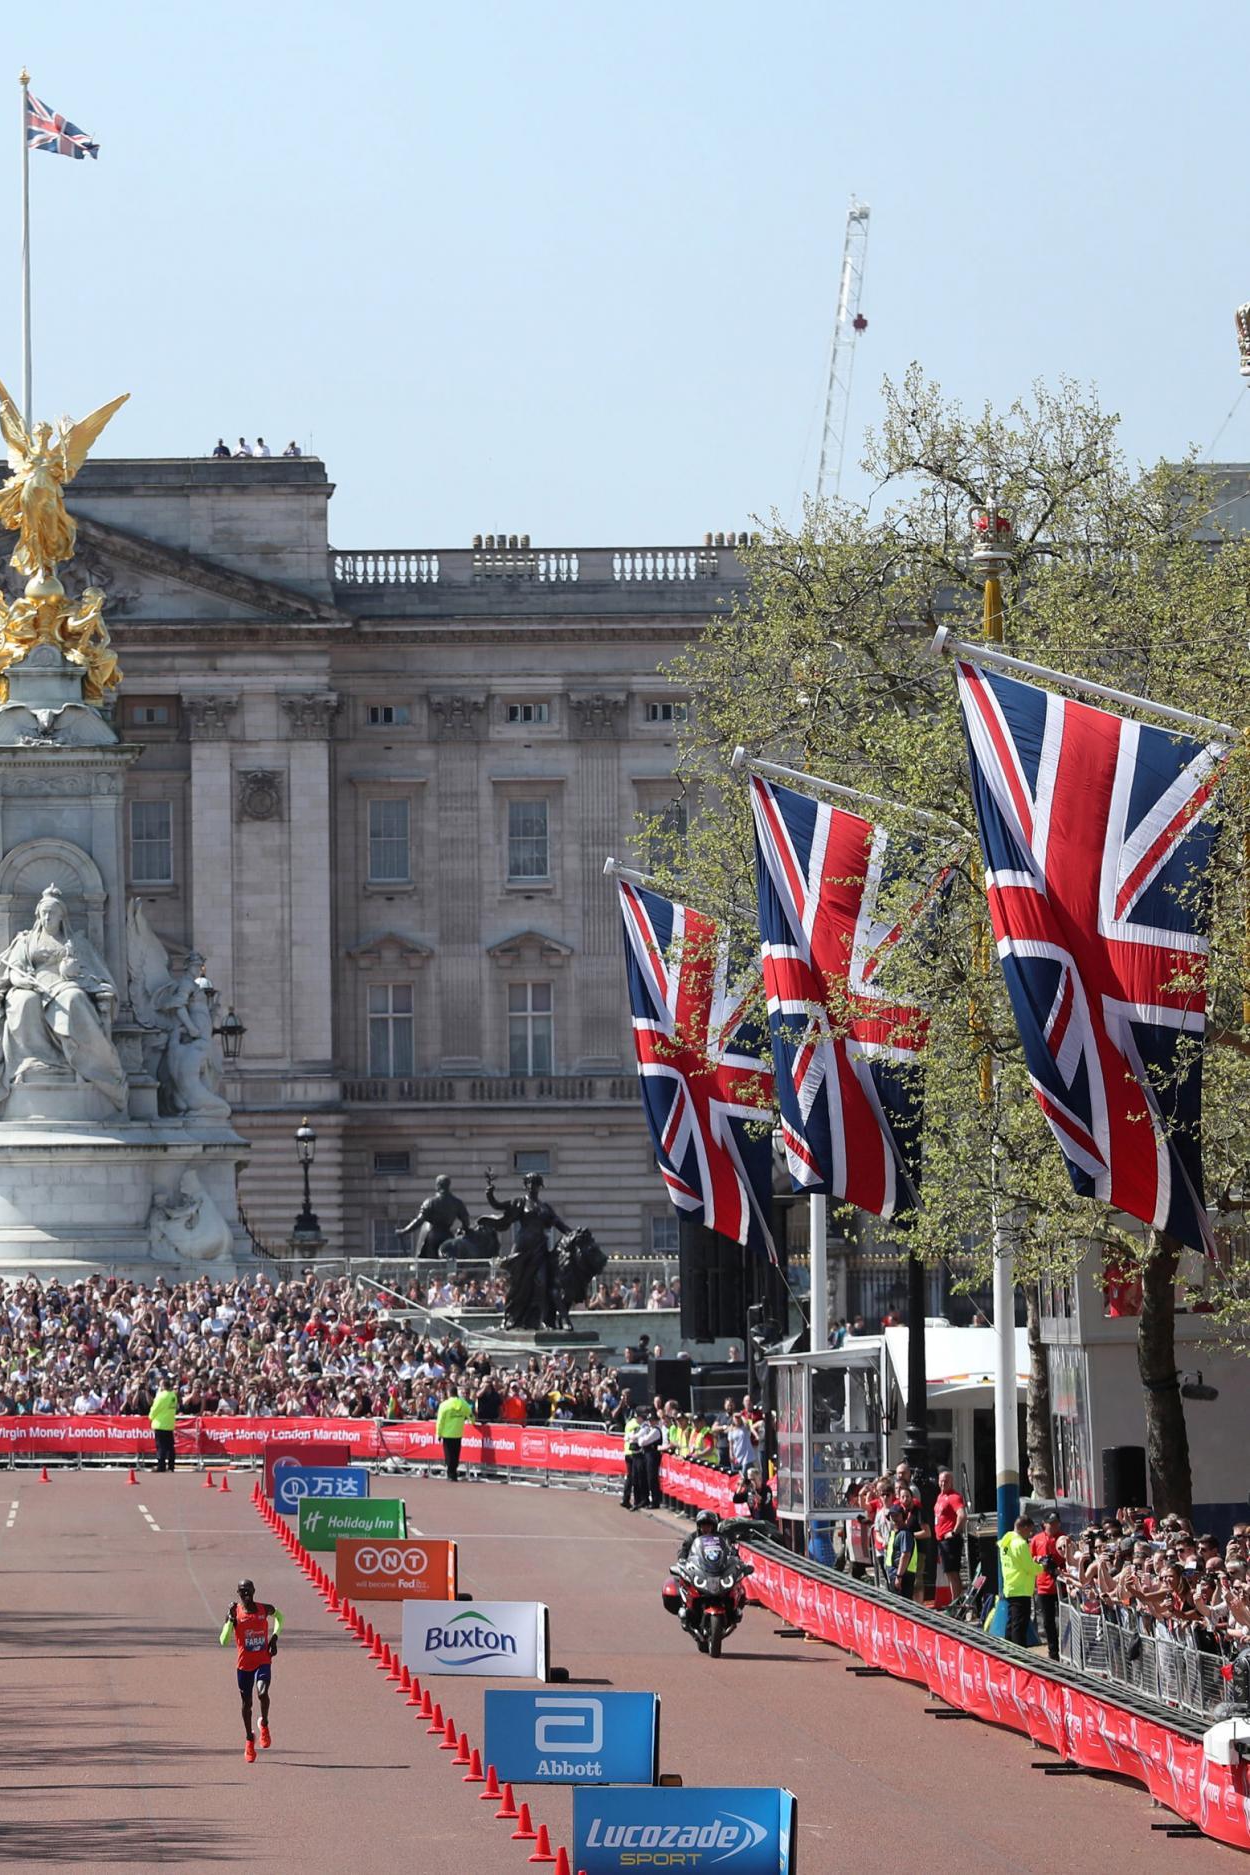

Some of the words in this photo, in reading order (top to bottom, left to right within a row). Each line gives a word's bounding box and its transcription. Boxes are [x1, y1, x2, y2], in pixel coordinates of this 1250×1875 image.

[29, 1428, 66, 1440] Money
[68, 1428, 105, 1439] London
[108, 1428, 155, 1439] Marathon
[205, 1429, 234, 1441] Virgin
[235, 1429, 269, 1441] Money
[271, 1429, 311, 1440] London
[313, 1429, 360, 1441] Marathon
[408, 1432, 434, 1446] Virgin
[461, 1437, 482, 1448] ondon
[483, 1438, 515, 1450] Marathon
[550, 1442, 570, 1458] Virgin
[312, 1477, 358, 1496] 万达
[328, 1516, 374, 1532] Holiday
[374, 1517, 394, 1529] Inn
[359, 1552, 423, 1571] TNT
[368, 1581, 395, 1589] become
[425, 1626, 517, 1654] Buxton
[536, 1760, 602, 1777] Abbott
[586, 1819, 740, 1848] Lucozade
[620, 1853, 702, 1866] SPORT
